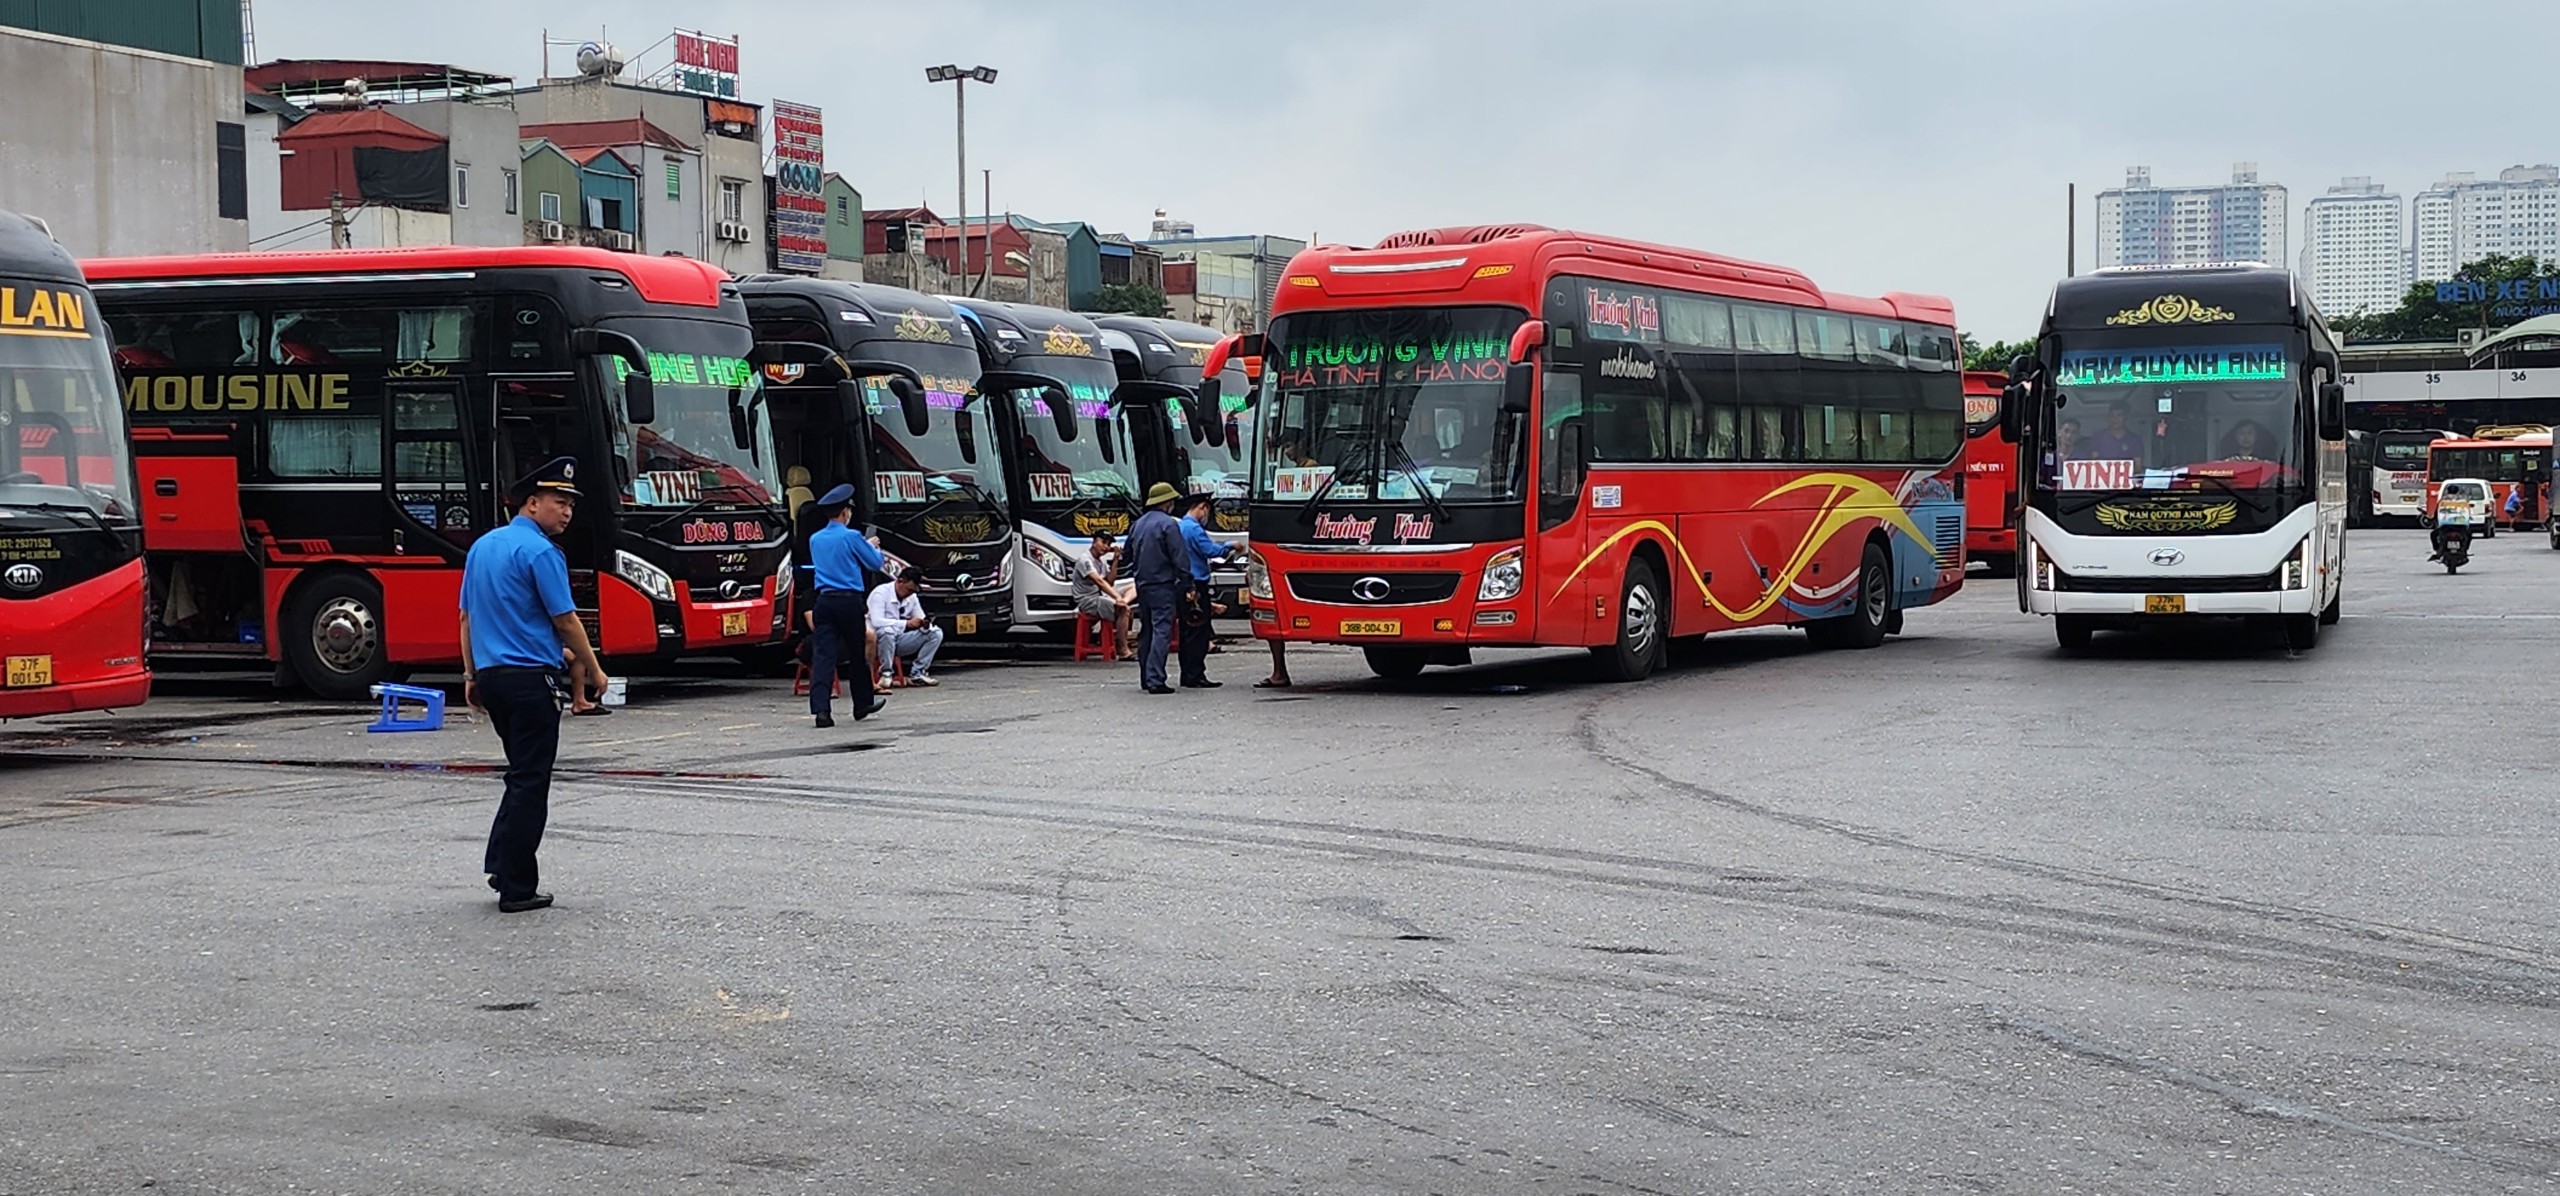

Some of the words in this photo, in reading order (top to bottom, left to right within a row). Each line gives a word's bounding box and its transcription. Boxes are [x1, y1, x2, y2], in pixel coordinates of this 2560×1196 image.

[2496, 280, 2529, 300] XE
[1, 287, 85, 329] LAN
[2228, 351, 2283, 375] ANH
[2425, 373, 2441, 384] 35
[2511, 371, 2527, 382] 36
[896, 474, 924, 498] VINH
[2065, 461, 2133, 489] VINH
[650, 473, 702, 503] VINH
[1030, 474, 1072, 499] VINH
[733, 521, 764, 541] HOA
[12, 569, 39, 583] KIA
[20, 658, 39, 671] 37F
